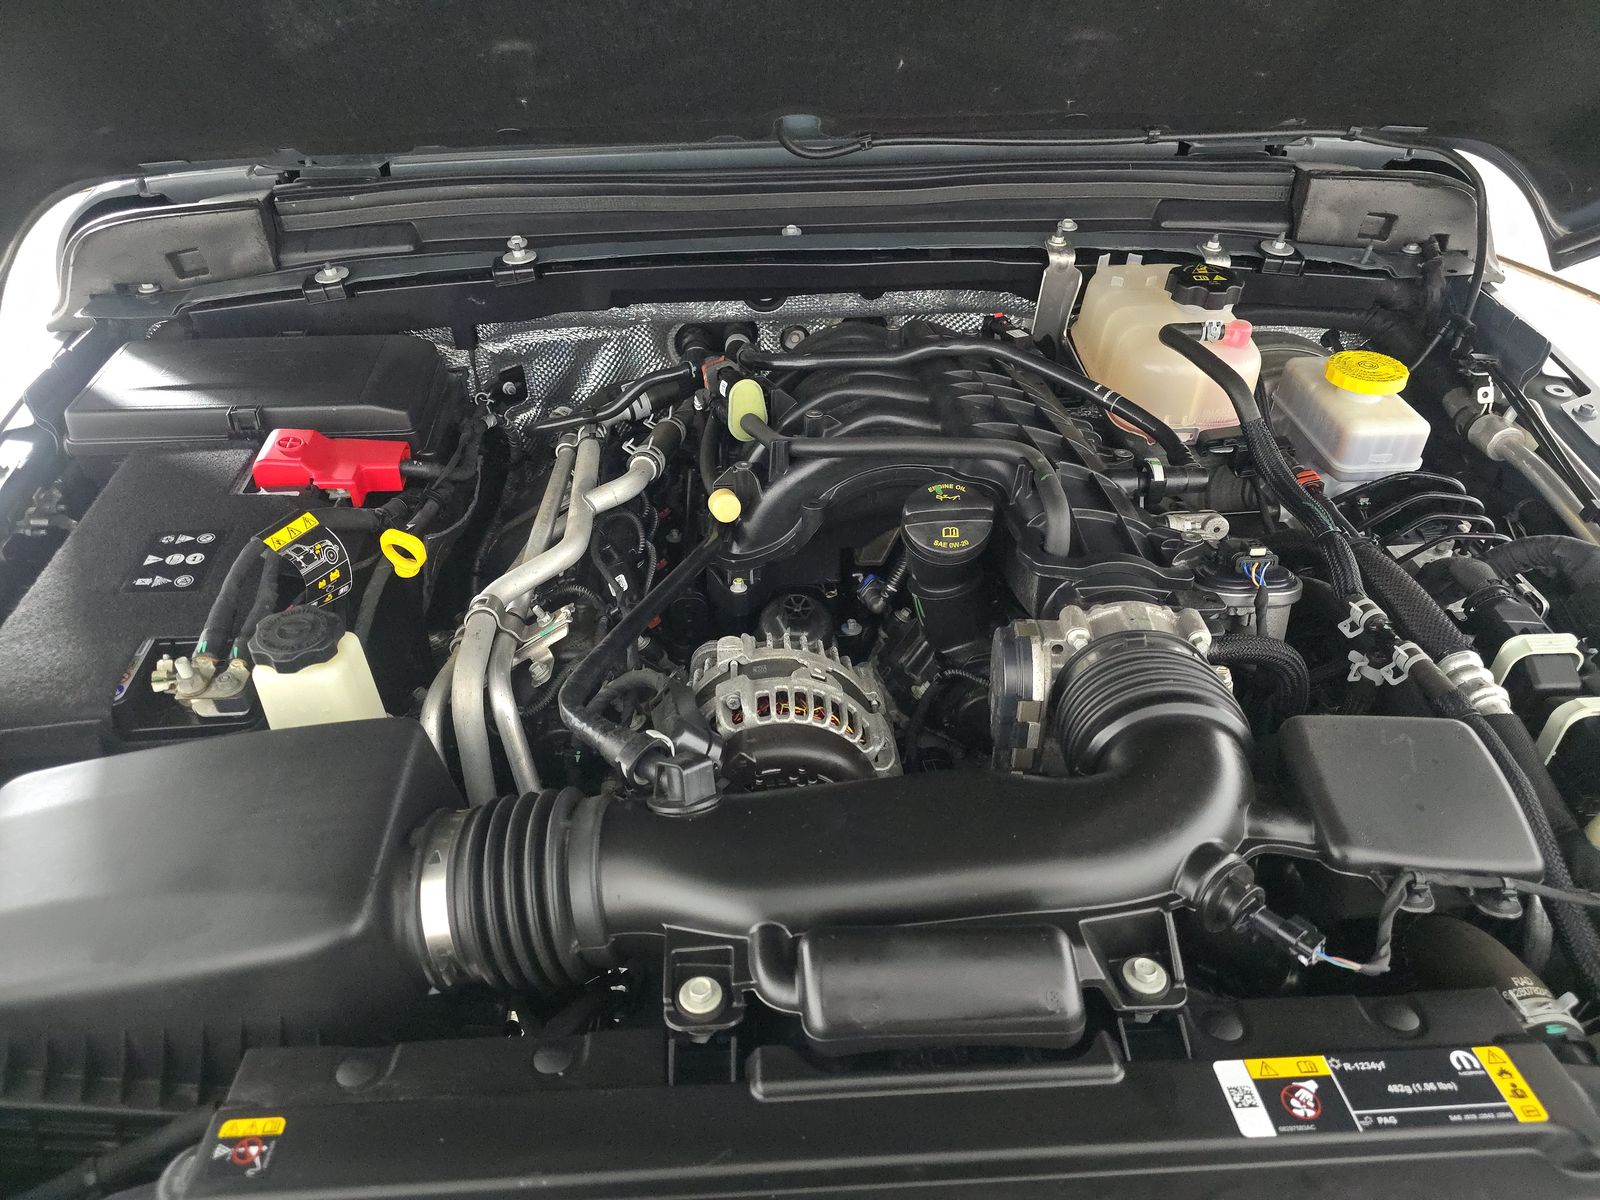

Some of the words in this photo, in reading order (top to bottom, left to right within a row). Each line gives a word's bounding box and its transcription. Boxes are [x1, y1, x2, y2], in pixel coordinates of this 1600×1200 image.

[955, 484, 966, 493] OIL
[933, 540, 948, 548] SAE
[949, 540, 969, 549] 0W-20
[1511, 976, 1534, 987] RAD
[1343, 1060, 1386, 1071] R-1234yf
[1376, 1116, 1398, 1125] PAG
